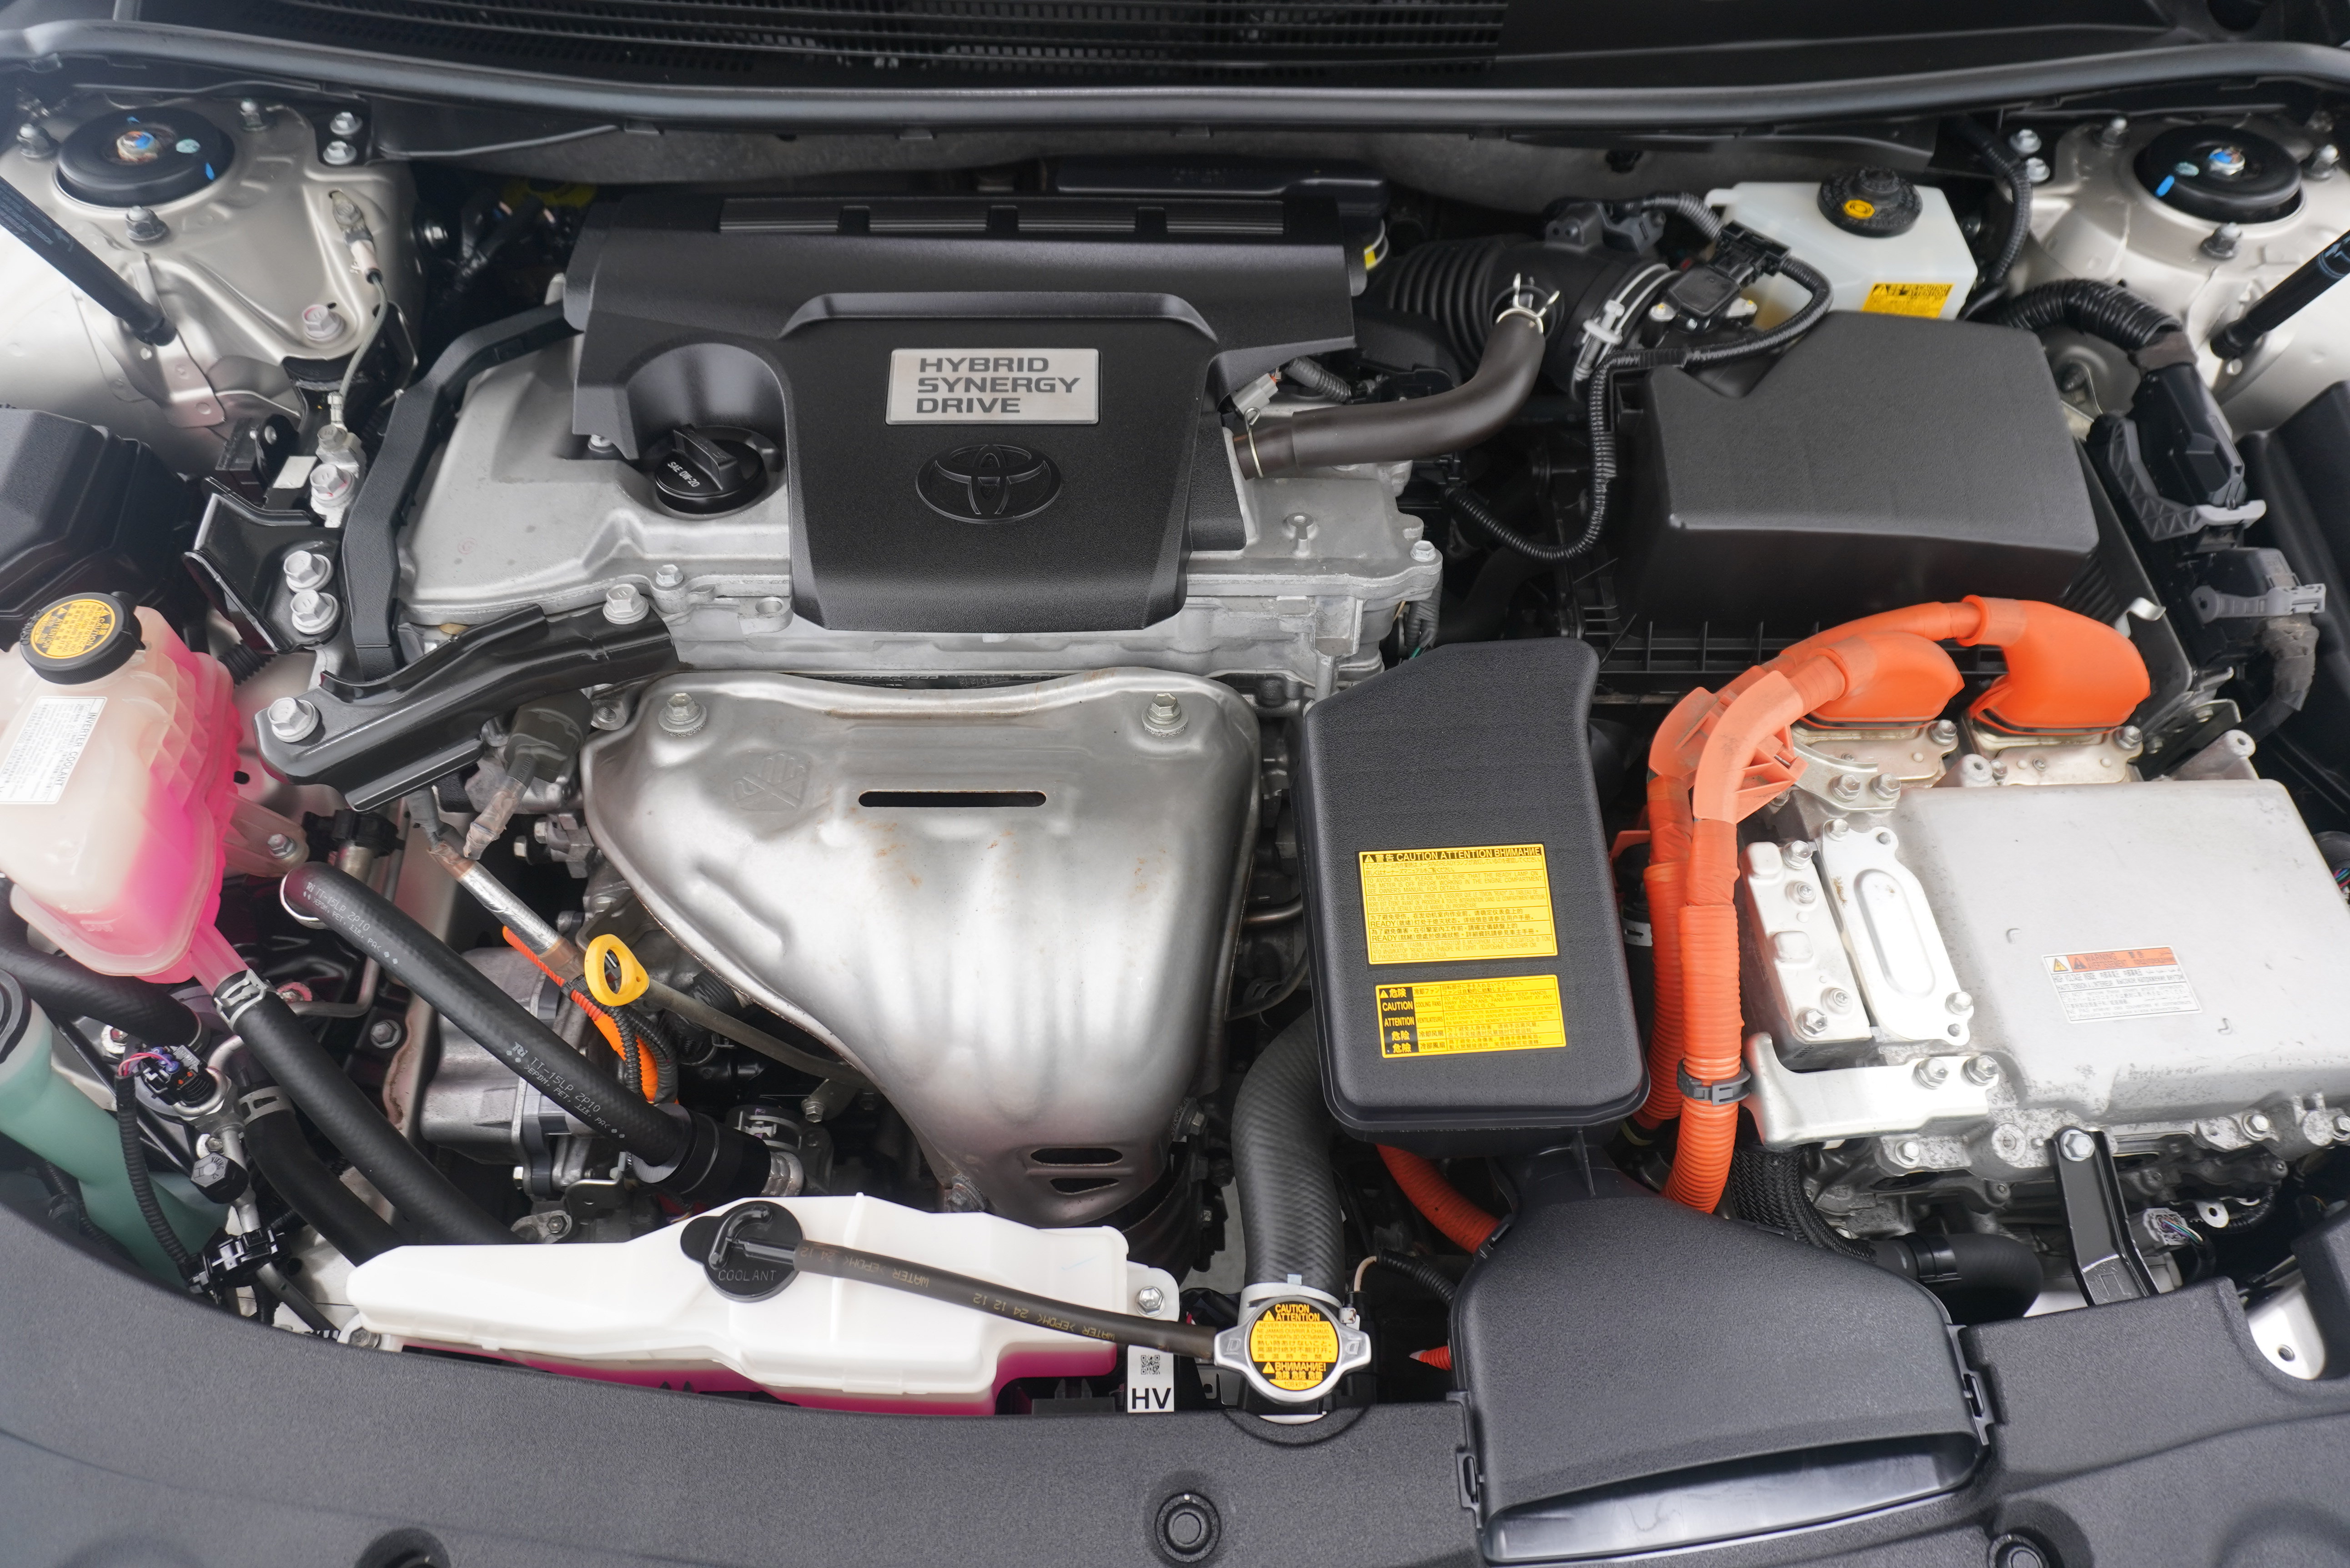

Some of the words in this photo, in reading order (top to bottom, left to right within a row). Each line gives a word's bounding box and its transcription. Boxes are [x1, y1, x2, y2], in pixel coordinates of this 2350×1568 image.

[919, 357, 1049, 372] HYBRID
[918, 377, 1080, 393] SYNERGY
[917, 398, 1020, 413] DRIVE
[667, 462, 683, 472] SAE
[679, 471, 700, 487] 0W-20
[20, 609, 44, 645] DENSO
[42, 618, 62, 648] ATTENTION
[87, 618, 105, 646] CAUTION
[74, 713, 97, 747] INVERTER
[55, 752, 78, 786] COOLANT
[1375, 854, 1394, 862] 警告
[1396, 852, 1438, 861] CAUTION
[1440, 849, 1492, 859] ATTENTION
[1494, 847, 1541, 857] ВНИМАНИЕ
[314, 886, 346, 915] TT-15LP
[331, 910, 347, 925] PET,
[2084, 953, 2117, 962] WARNING
[1389, 988, 1406, 998] 危険
[1381, 1000, 1413, 1011] CAUTION
[1383, 1016, 1415, 1027] ATTENTION
[1391, 1030, 1411, 1041] 危险
[1392, 1042, 1411, 1053] 危險
[529, 1056, 575, 1094] TT-15LP
[553, 1086, 573, 1103] PET,
[595, 1116, 610, 1130] PA<
[718, 1269, 777, 1281] COOLANT
[892, 1268, 929, 1287] WATER
[972, 1292, 988, 1306] 12
[993, 1299, 1006, 1312] 12
[1012, 1306, 1029, 1319] 24
[1275, 1304, 1310, 1313] CAUTION
[1037, 1313, 1075, 1332] >EPDM<
[1275, 1313, 1320, 1322] ATTENTION
[1081, 1325, 1115, 1341] WATER
[1275, 1362, 1326, 1372] ВНИМАНИЕ!
[1132, 1388, 1172, 1409] HV
